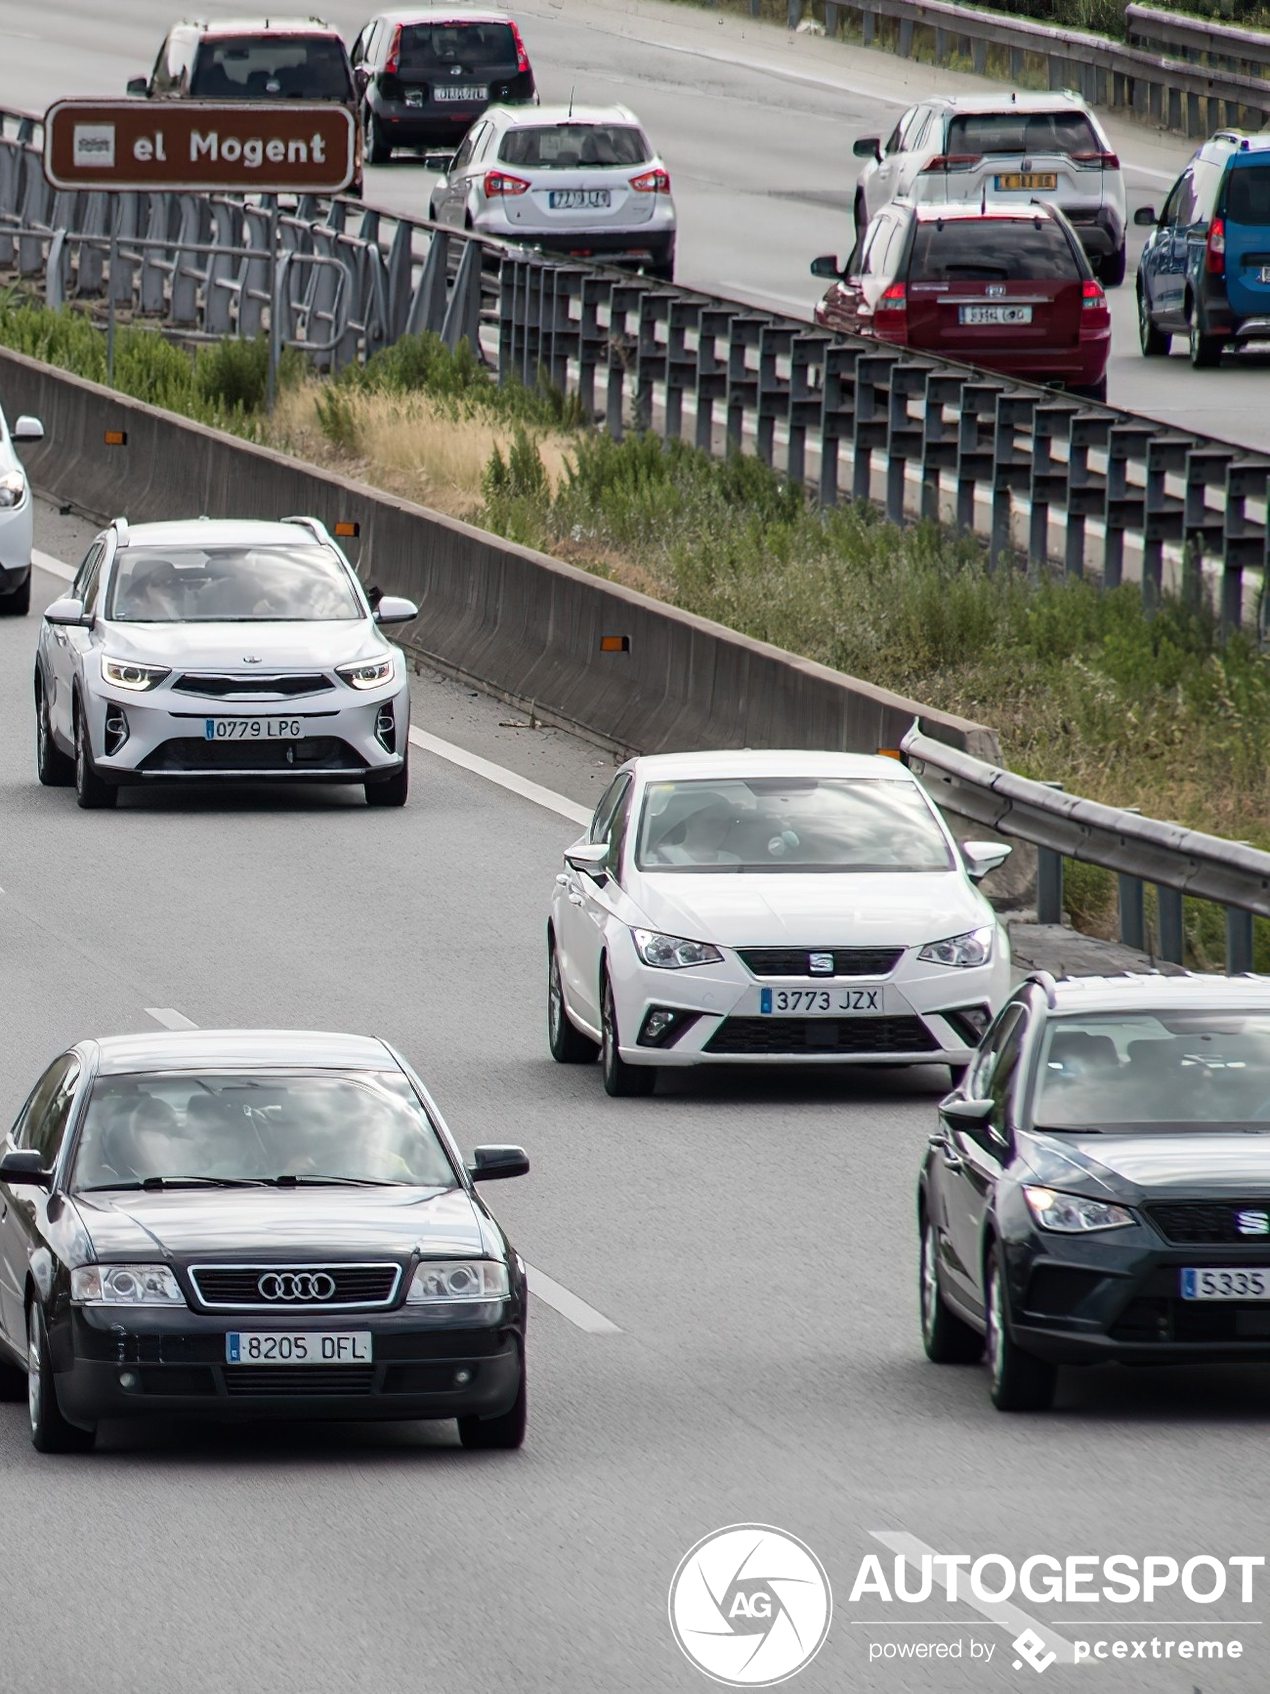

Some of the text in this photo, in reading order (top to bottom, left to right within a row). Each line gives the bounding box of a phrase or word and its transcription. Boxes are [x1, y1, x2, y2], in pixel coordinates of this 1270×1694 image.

[133, 131, 326, 167] el Mogent
[216, 720, 301, 738] 0779 LPG
[777, 991, 878, 1011] 3773 JZX
[1201, 1272, 1266, 1296] 5335
[248, 1336, 365, 1360] 8205 DFL
